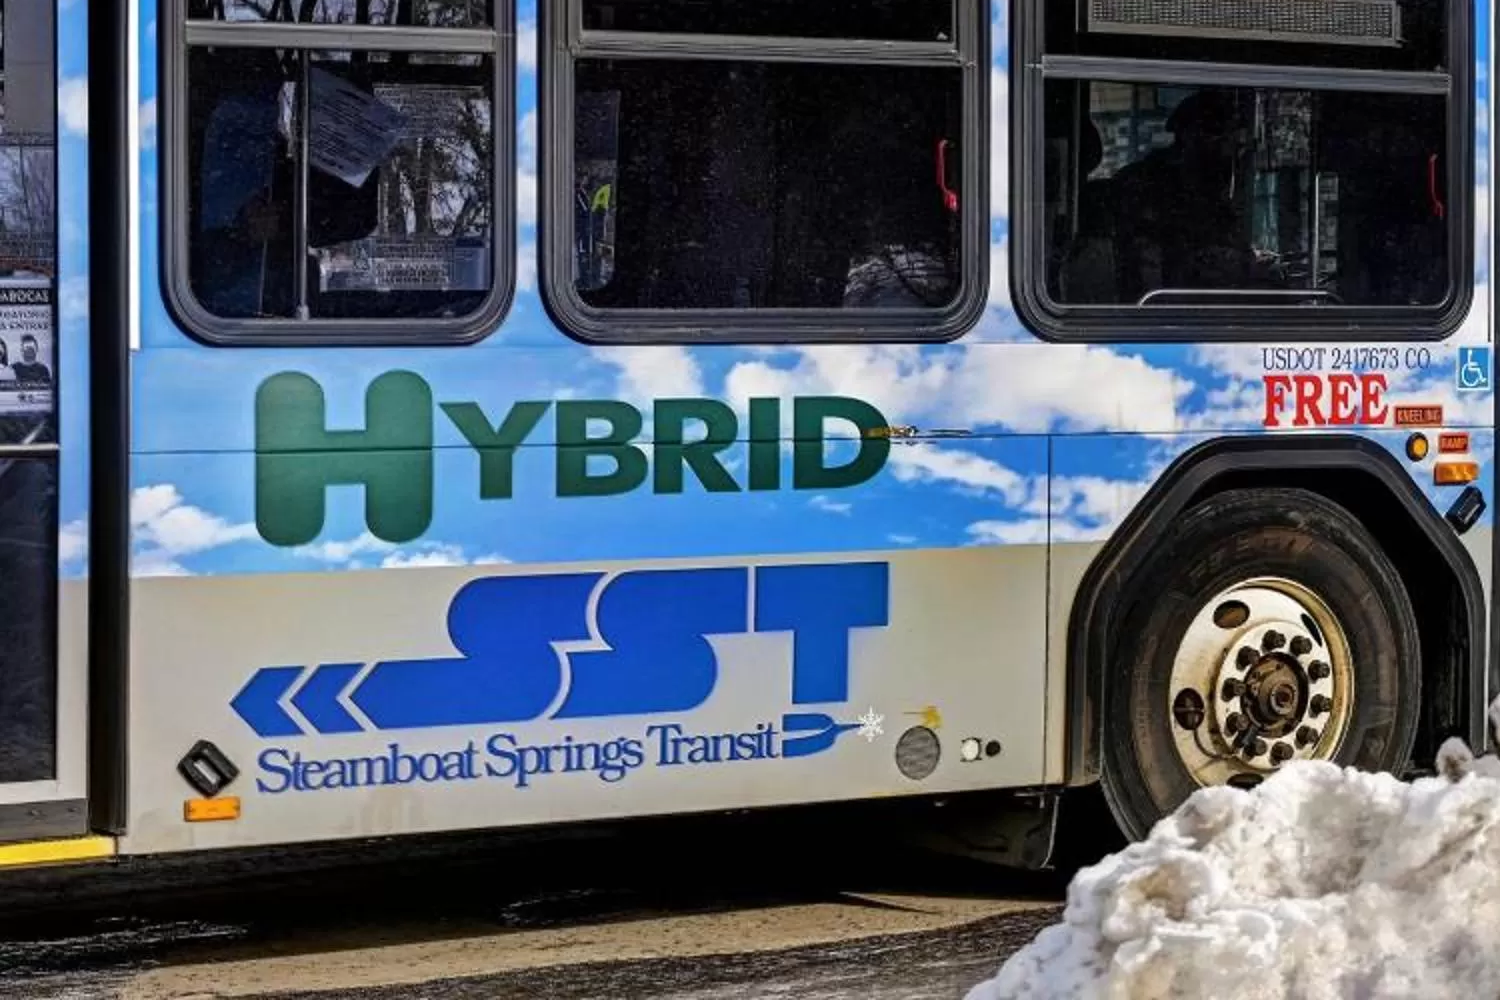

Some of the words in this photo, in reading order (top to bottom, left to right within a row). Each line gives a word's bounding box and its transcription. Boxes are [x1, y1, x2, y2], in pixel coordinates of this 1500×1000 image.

[1262, 347, 1326, 370] USDOT
[1331, 348, 1399, 370] 2417673
[1405, 347, 1431, 370] CO
[1262, 373, 1389, 427] FREE
[253, 370, 892, 547] HYBRID
[349, 561, 890, 723] SST
[256, 740, 480, 794] Steamboat
[484, 732, 646, 788] Springs
[646, 722, 780, 768] Transit
